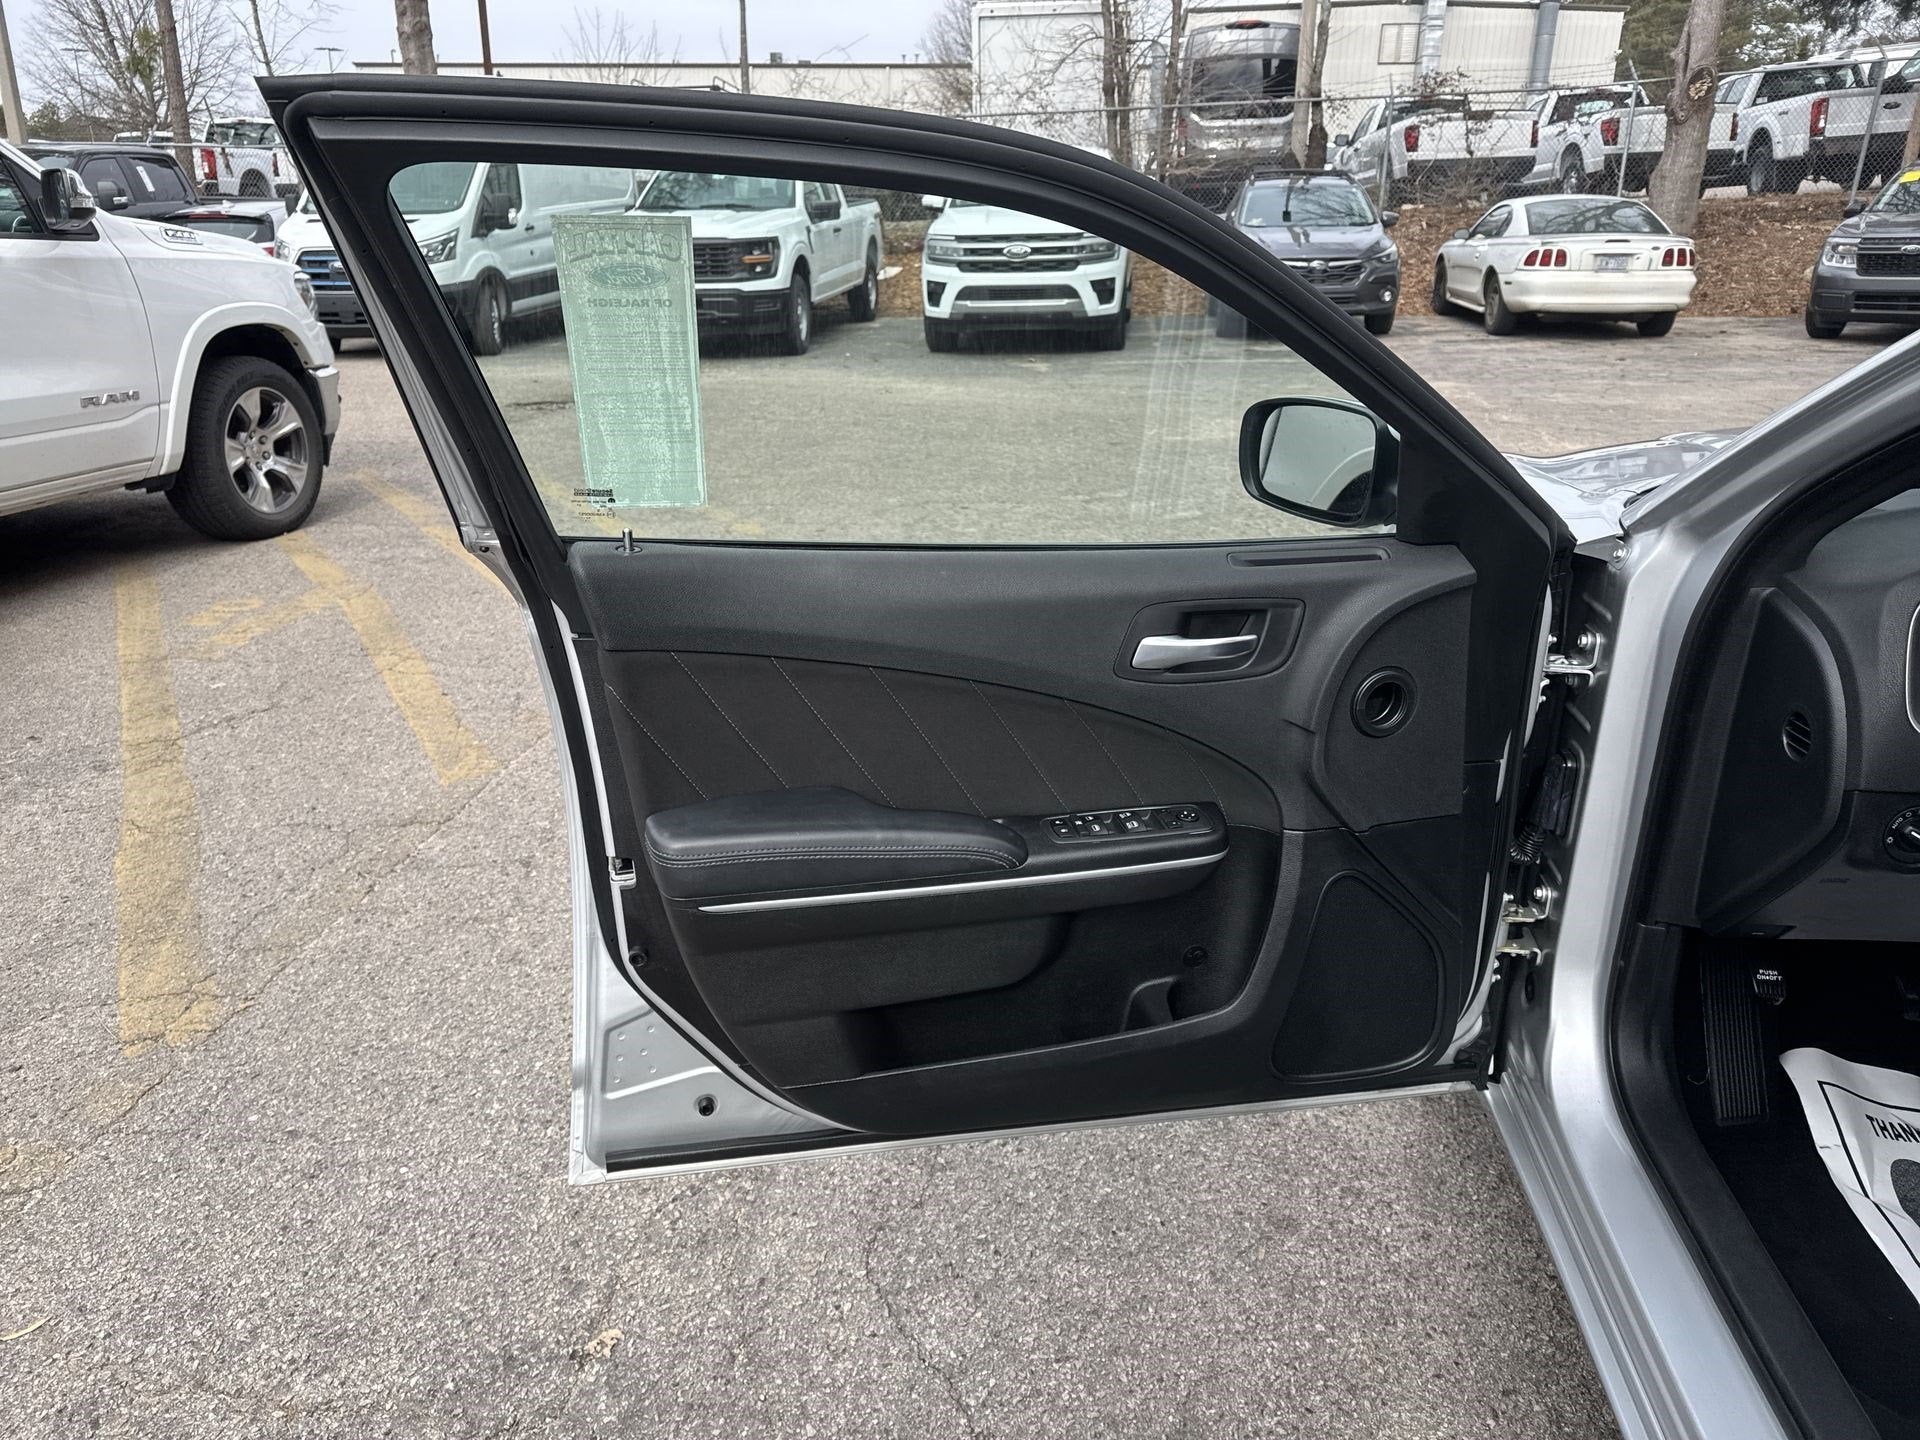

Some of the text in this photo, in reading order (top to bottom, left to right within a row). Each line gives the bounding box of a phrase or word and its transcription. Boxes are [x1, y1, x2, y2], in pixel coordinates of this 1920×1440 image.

[80, 389, 141, 409] RAM
[1891, 817, 1904, 830] AUTO
[1758, 968, 1778, 976] PUSH
